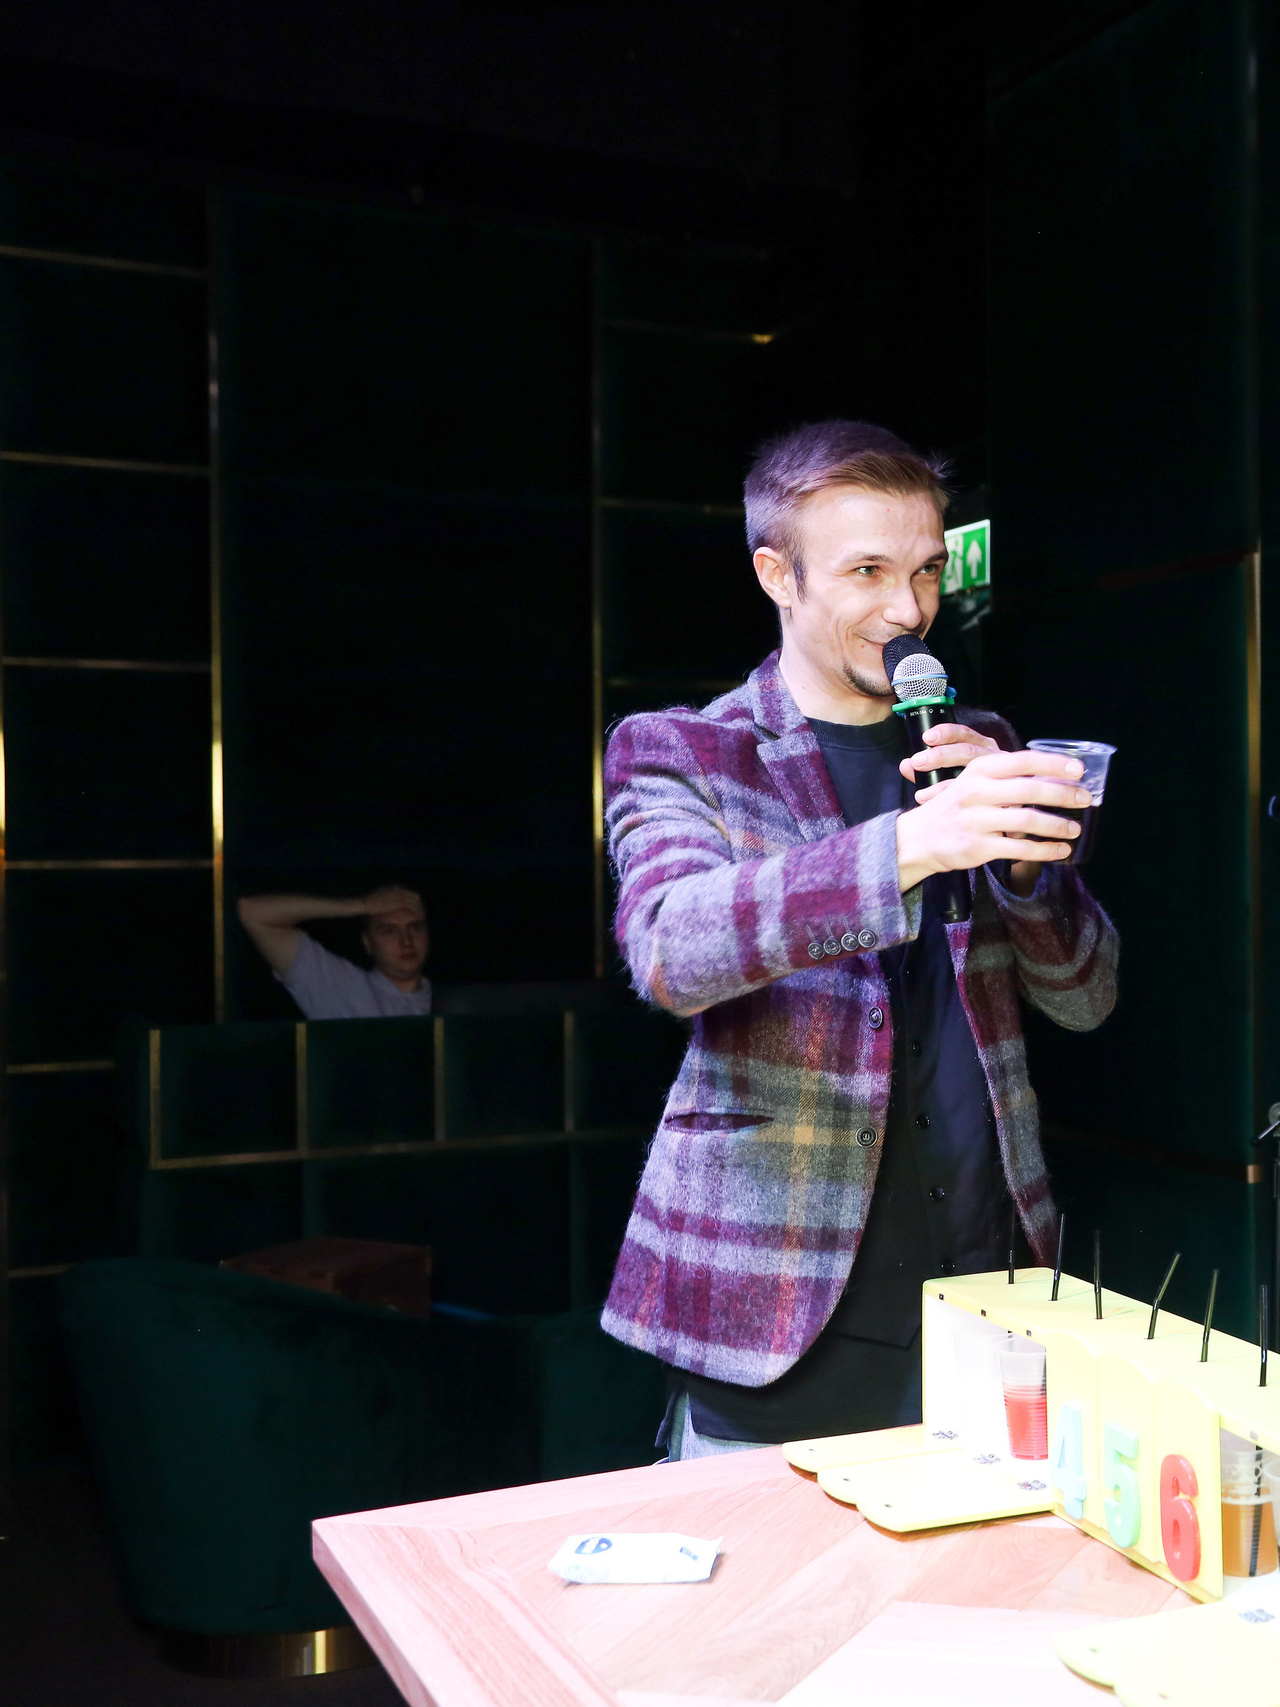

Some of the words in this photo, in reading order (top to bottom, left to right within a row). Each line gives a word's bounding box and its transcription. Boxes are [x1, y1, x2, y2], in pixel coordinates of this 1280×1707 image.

[1050, 1402, 1087, 1520] 4
[1104, 1422, 1142, 1548] 5
[1160, 1454, 1202, 1582] 6
